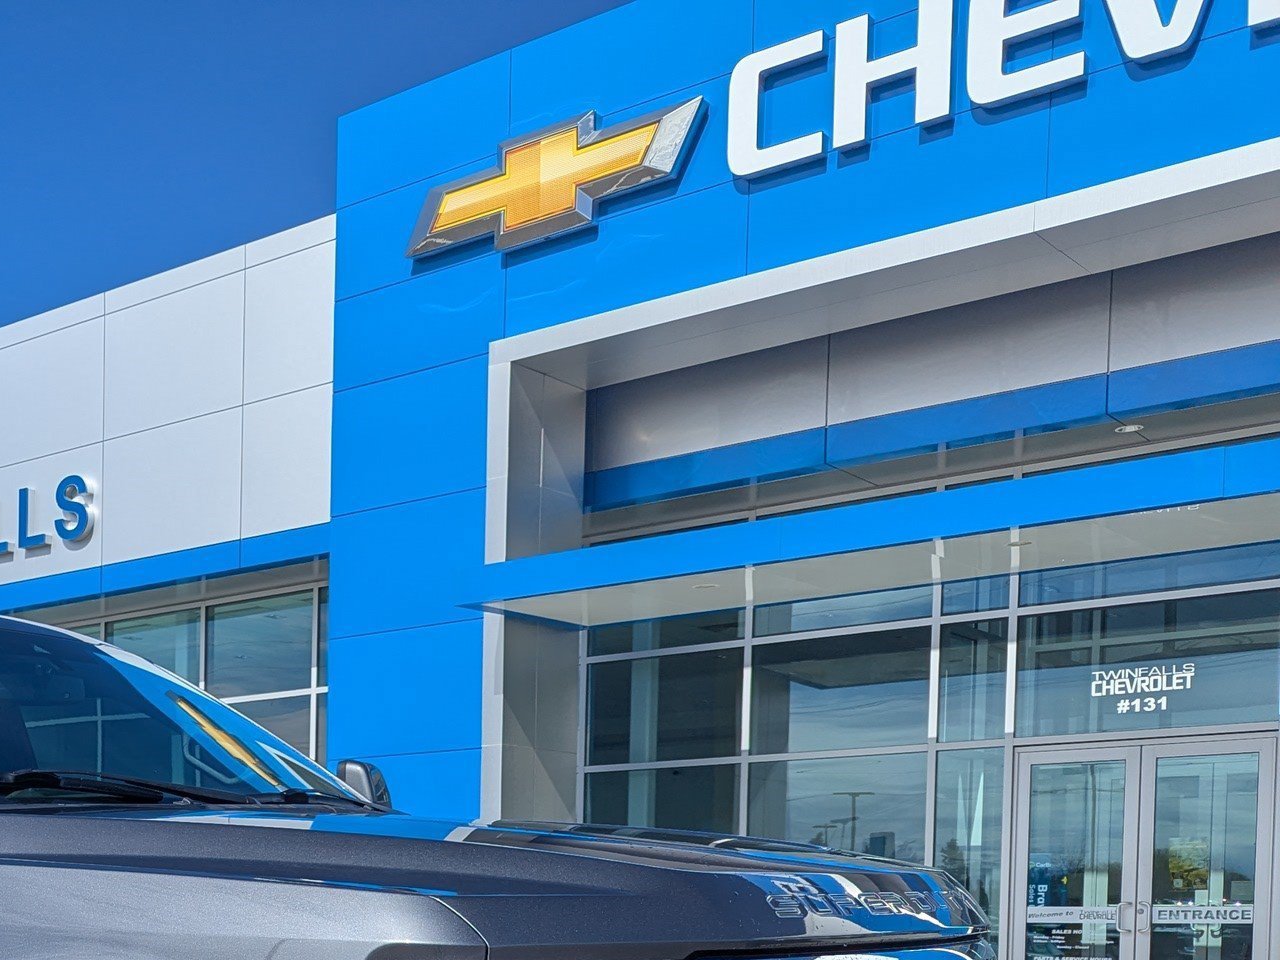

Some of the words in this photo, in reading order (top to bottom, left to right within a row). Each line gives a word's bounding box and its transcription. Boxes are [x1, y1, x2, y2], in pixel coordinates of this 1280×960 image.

[727, 0, 1280, 178] CHE
[1091, 672, 1195, 697] CHEVROLET
[1116, 696, 1167, 713] #131
[1028, 911, 1064, 919] Welcome
[1157, 909, 1252, 920] ENTRANCE
